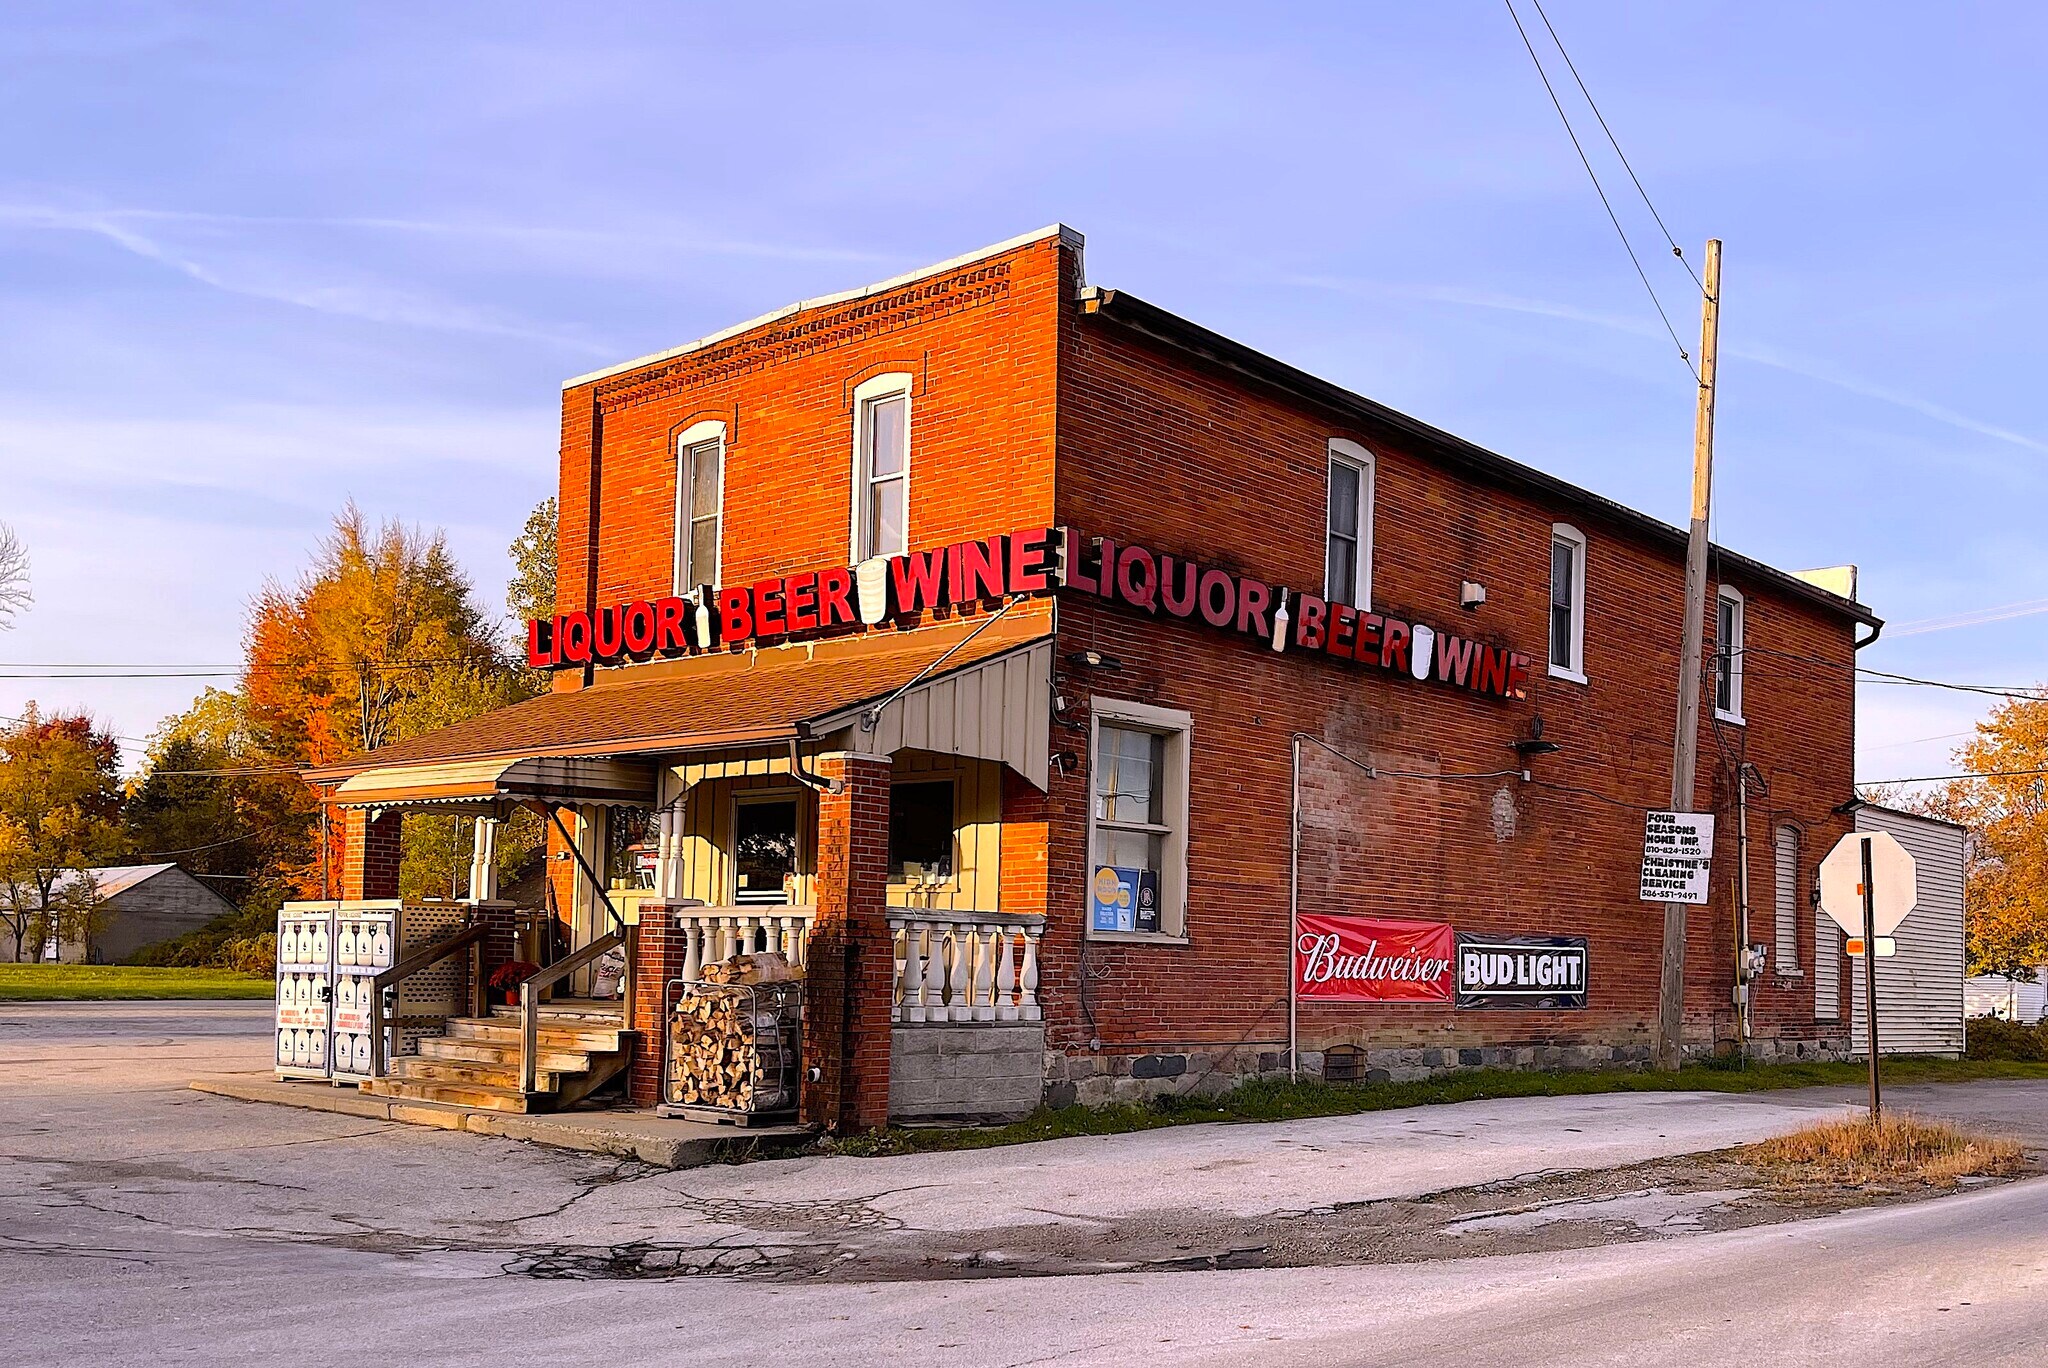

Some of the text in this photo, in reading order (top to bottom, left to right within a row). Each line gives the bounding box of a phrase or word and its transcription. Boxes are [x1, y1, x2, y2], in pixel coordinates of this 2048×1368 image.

[529, 527, 1047, 668] LIQUOR BEER WINE
[1066, 528, 1531, 701] LIQUOR BEER WINE
[1647, 813, 1676, 824] FOUR
[1646, 824, 1697, 835] SEASONS
[1646, 834, 1700, 846] HOME IMP.
[1643, 857, 1710, 870] CHRISTINE'S
[1642, 868, 1694, 879] CLEANING
[1641, 878, 1686, 889] SERVICE
[1298, 933, 1449, 983] Budweiser
[1463, 953, 1581, 985] BUD LIGHT
